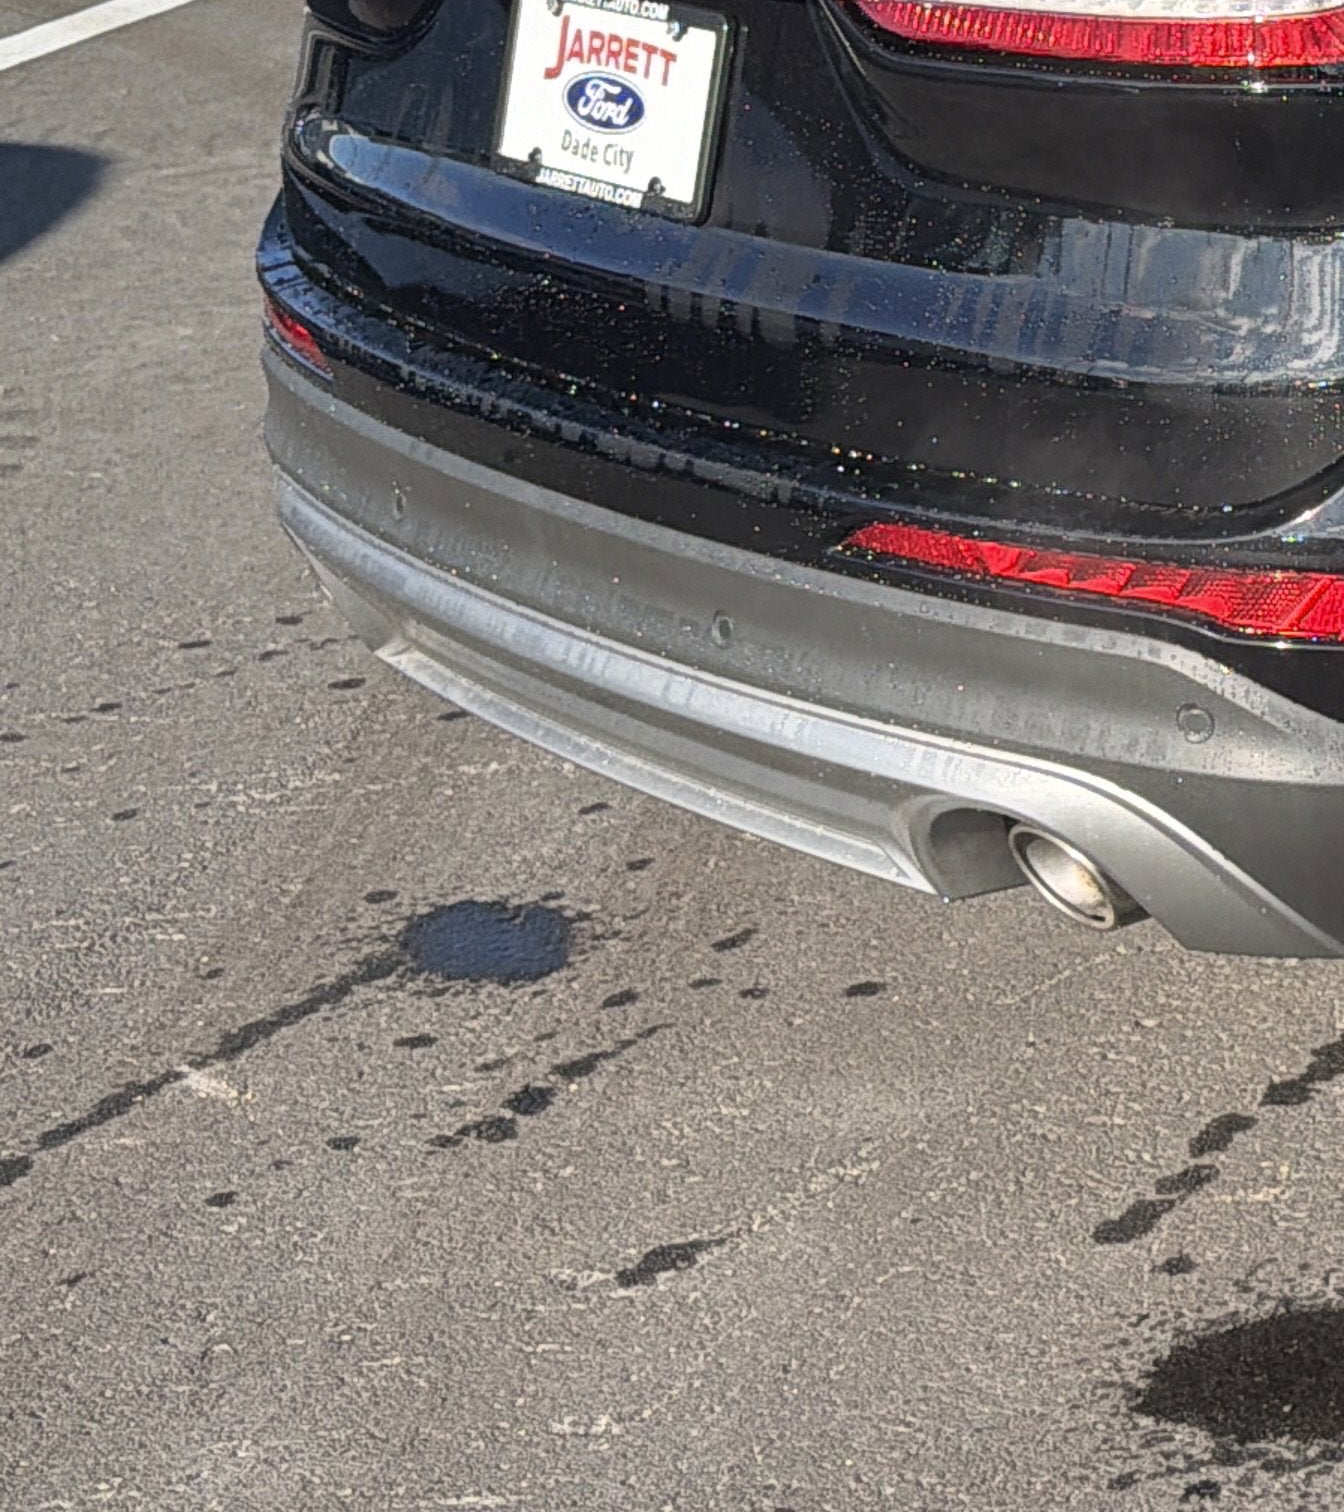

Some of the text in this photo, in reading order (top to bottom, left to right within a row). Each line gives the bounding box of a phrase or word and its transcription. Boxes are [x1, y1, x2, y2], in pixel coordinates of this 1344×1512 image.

[543, 15, 678, 86] JARRETT
[576, 78, 631, 126] Ford
[560, 129, 635, 174] Dade City
